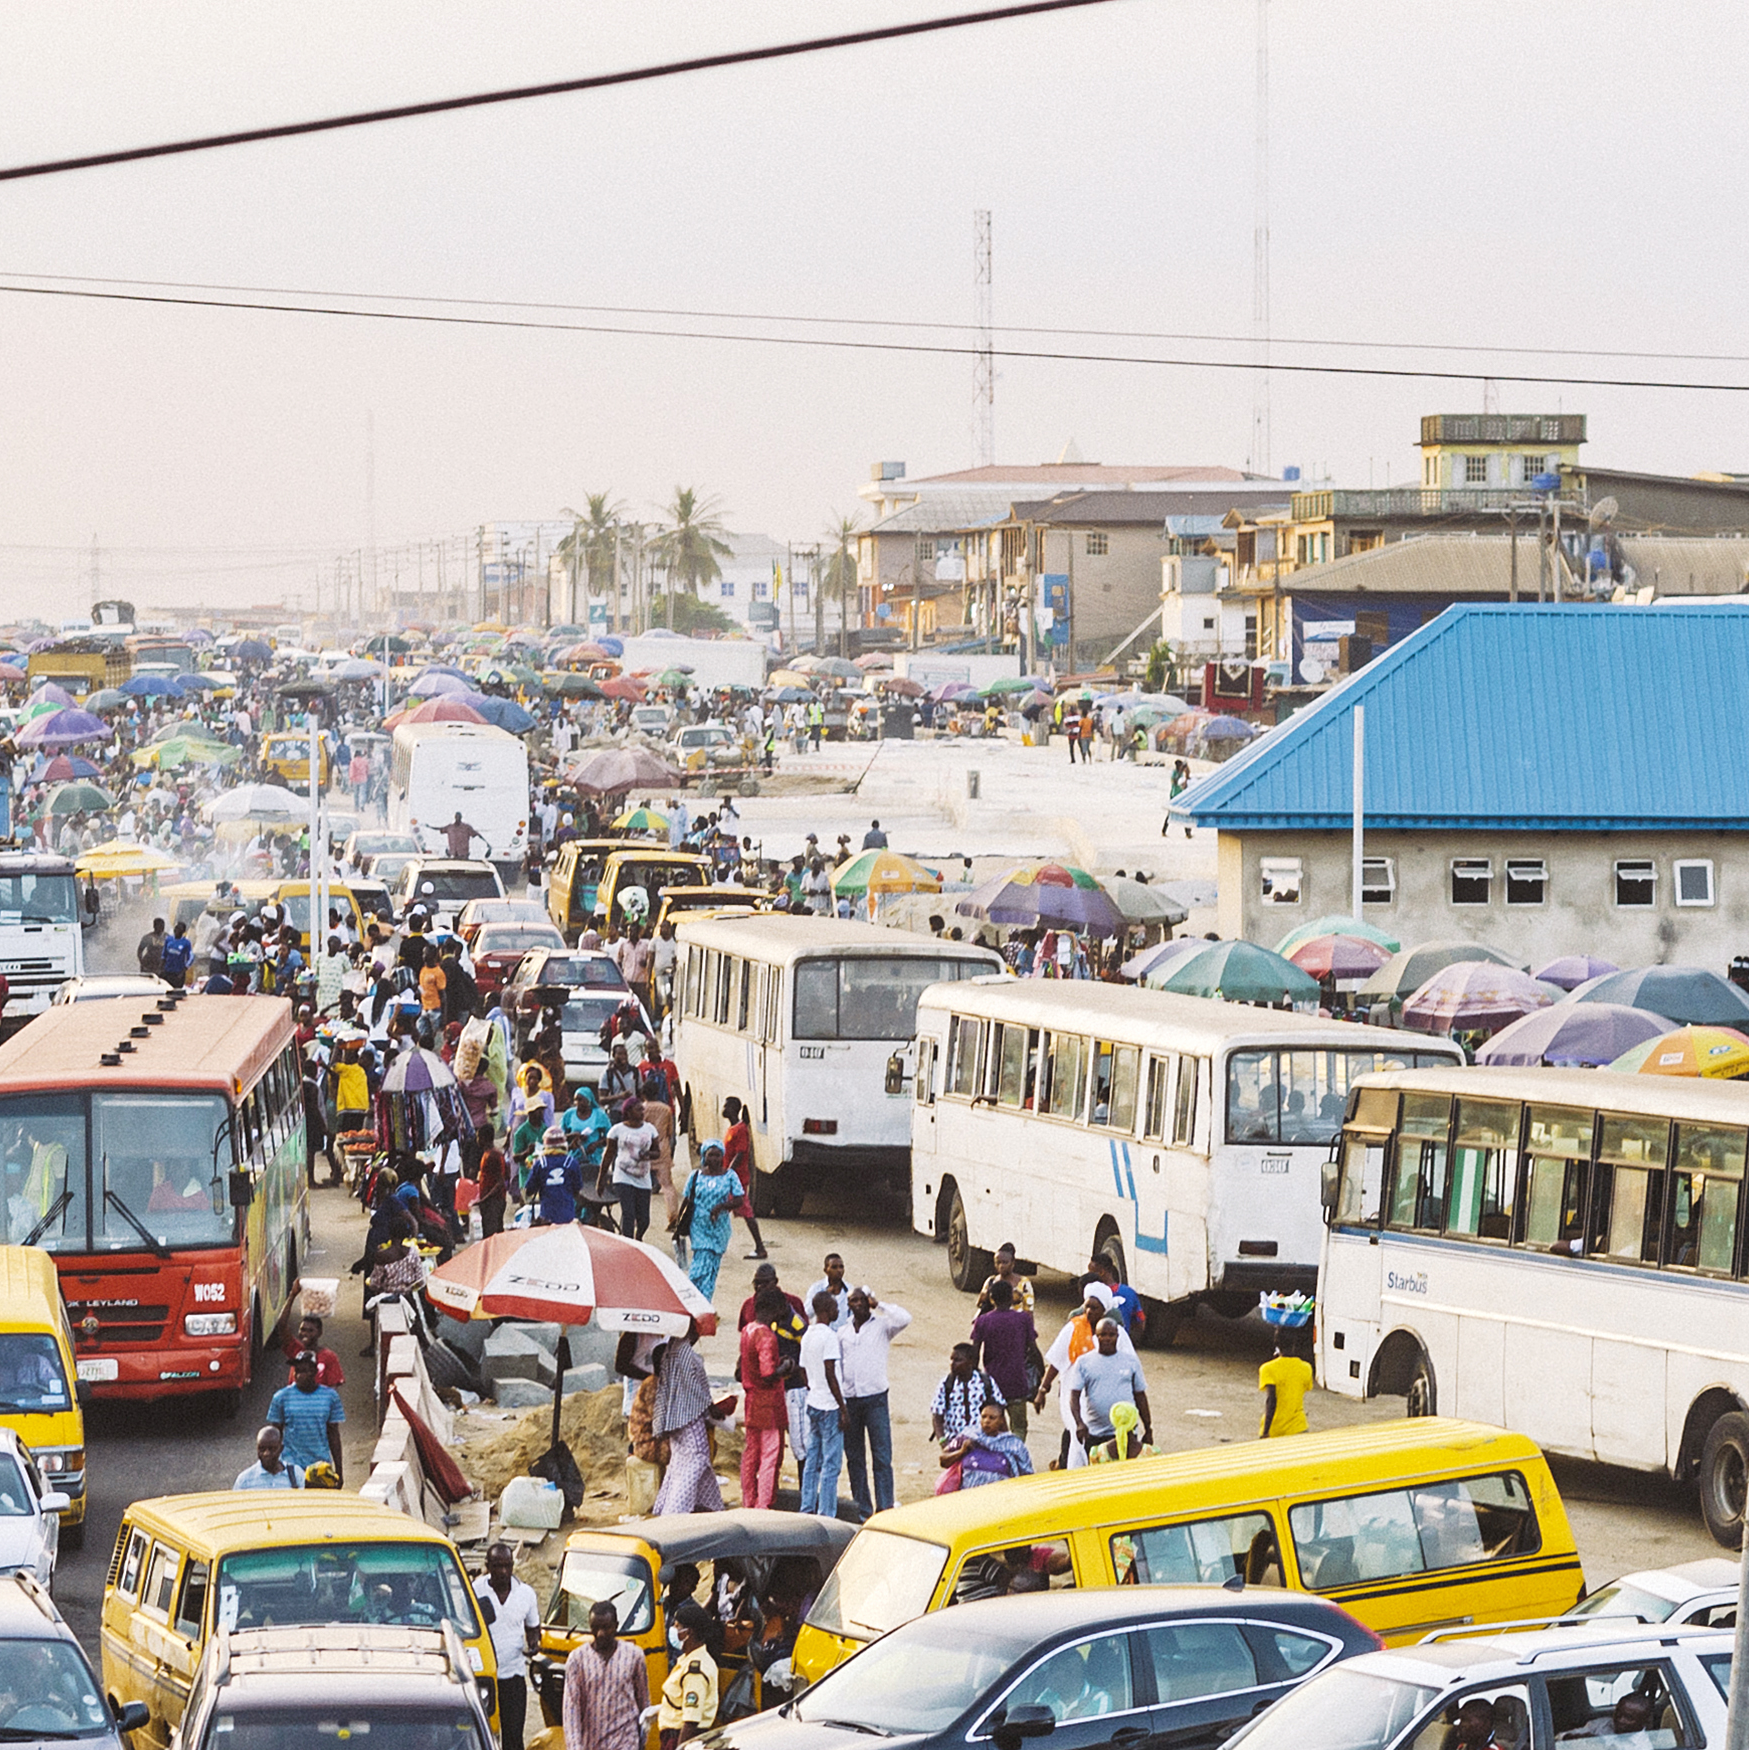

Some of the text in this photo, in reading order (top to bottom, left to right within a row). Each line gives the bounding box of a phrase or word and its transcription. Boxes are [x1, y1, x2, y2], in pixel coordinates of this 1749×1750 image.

[508, 1275, 581, 1292] ZEDD
[1387, 1271, 1428, 1294] Starbus
[86, 1299, 138, 1307] LEYLAND
[622, 1312, 661, 1323] ZEDD
